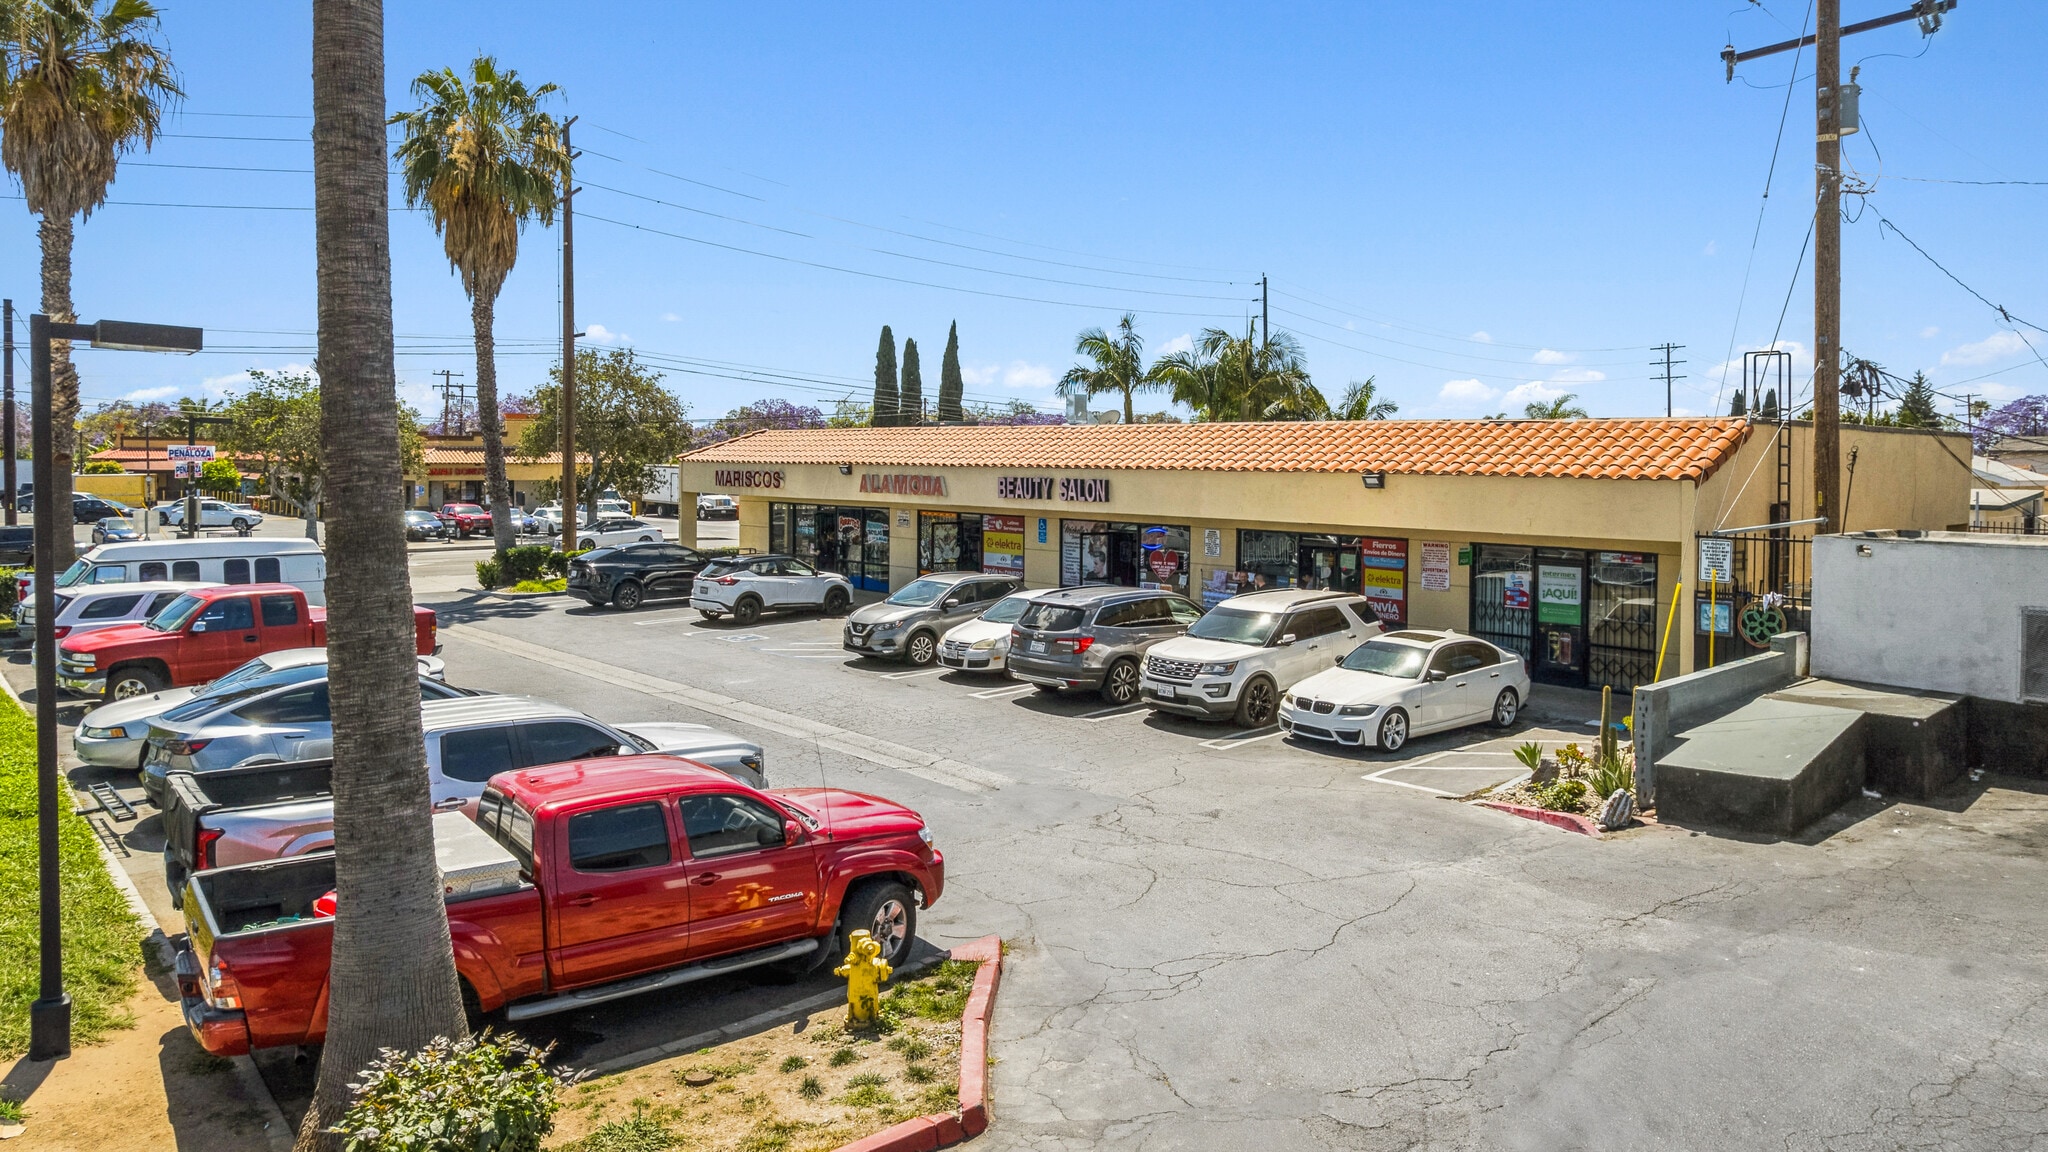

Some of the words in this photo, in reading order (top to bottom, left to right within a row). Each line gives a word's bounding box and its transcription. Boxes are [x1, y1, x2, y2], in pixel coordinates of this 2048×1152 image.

[715, 470, 783, 489] MARISCOS
[998, 477, 1053, 499] BEAUTY
[1059, 478, 1110, 502] SALON
[994, 538, 1022, 550] elektra
[1372, 541, 1397, 550] Fierros
[1375, 575, 1402, 585] elektra
[1542, 570, 1577, 579] intermex
[1542, 588, 1577, 600] ¡AQUÍ!
[768, 891, 804, 902] TACOMA
